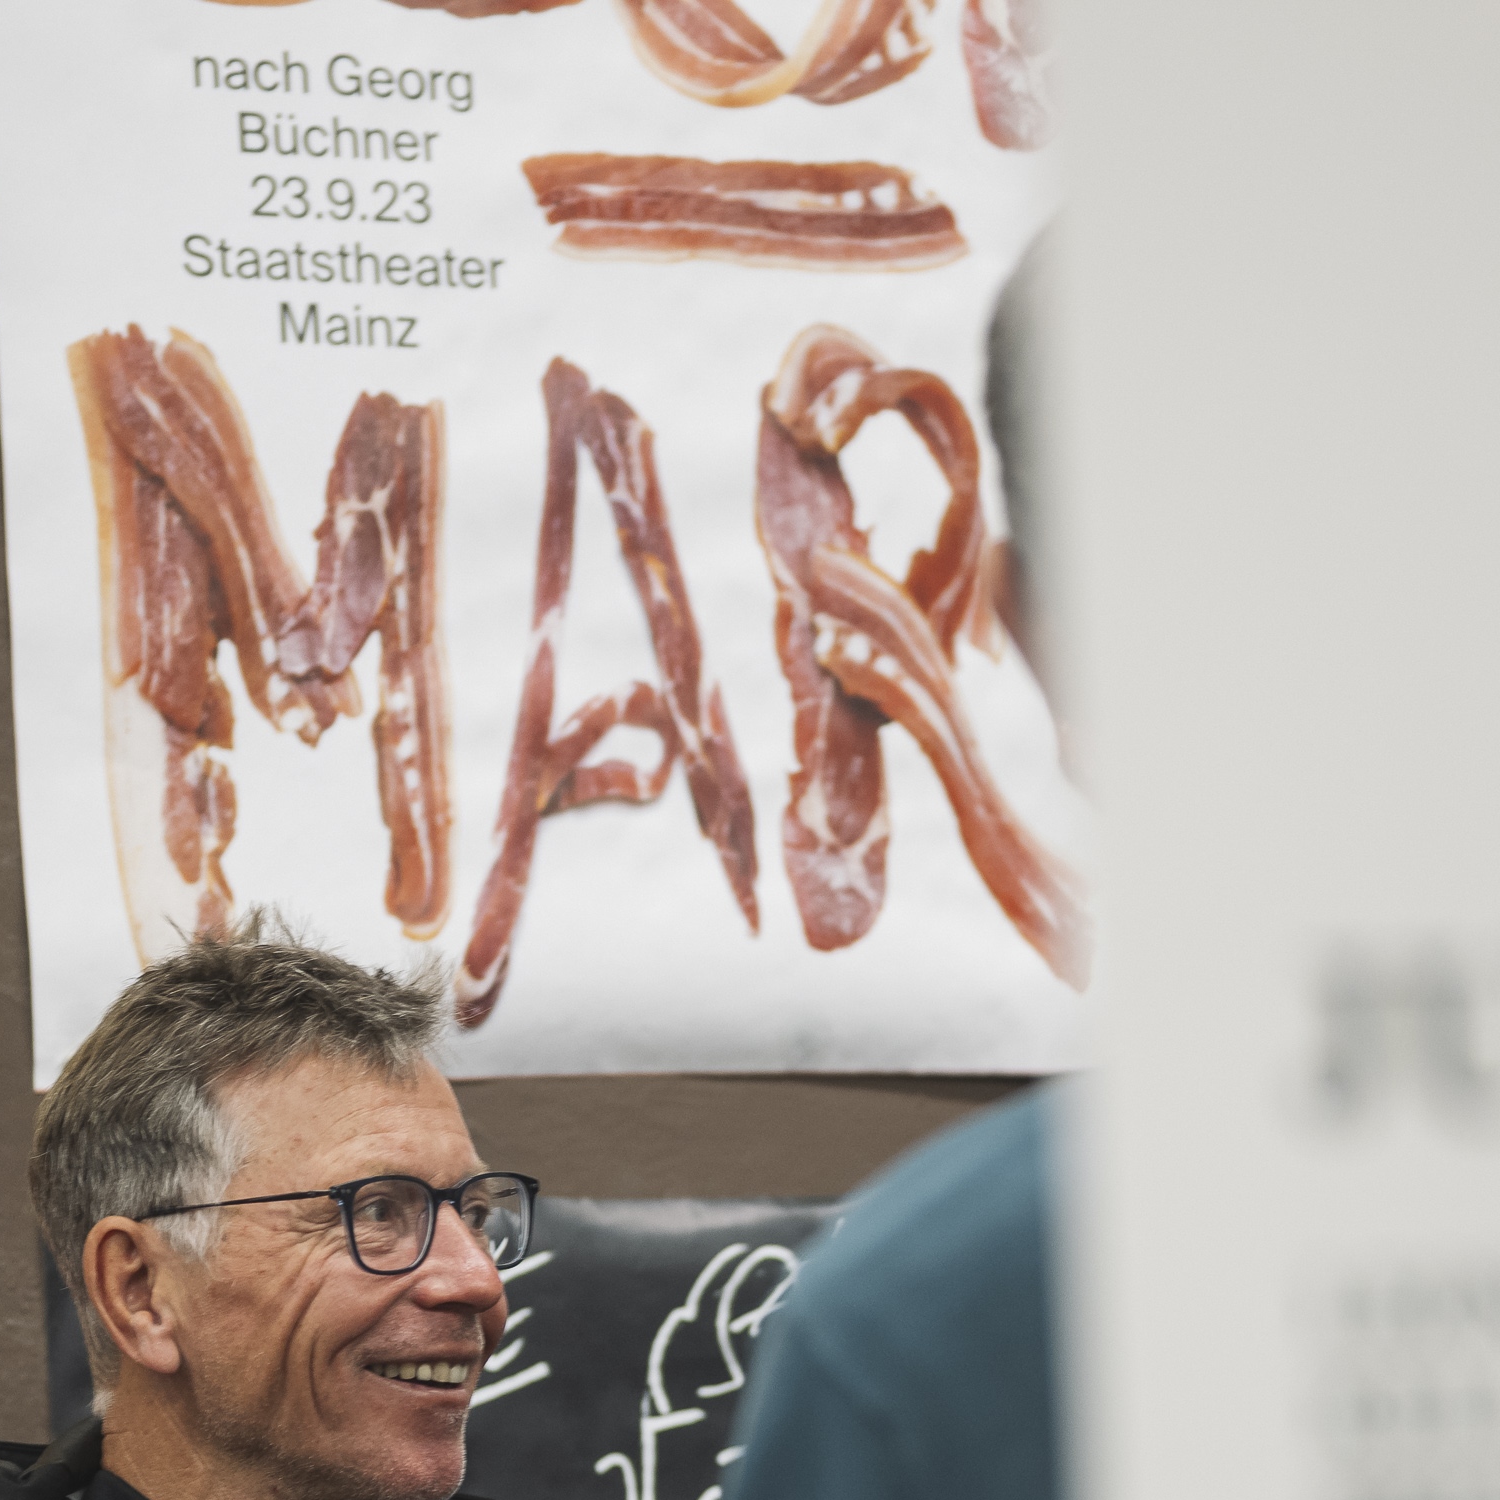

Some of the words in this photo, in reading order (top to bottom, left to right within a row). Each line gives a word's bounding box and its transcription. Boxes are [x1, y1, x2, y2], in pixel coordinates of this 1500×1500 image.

[194, 51, 310, 93] nach
[327, 53, 474, 112] Georg
[238, 111, 439, 161] Büchner
[251, 174, 432, 224] 23.9.23
[183, 234, 504, 289] Staatstheater
[278, 302, 420, 349] Mainz
